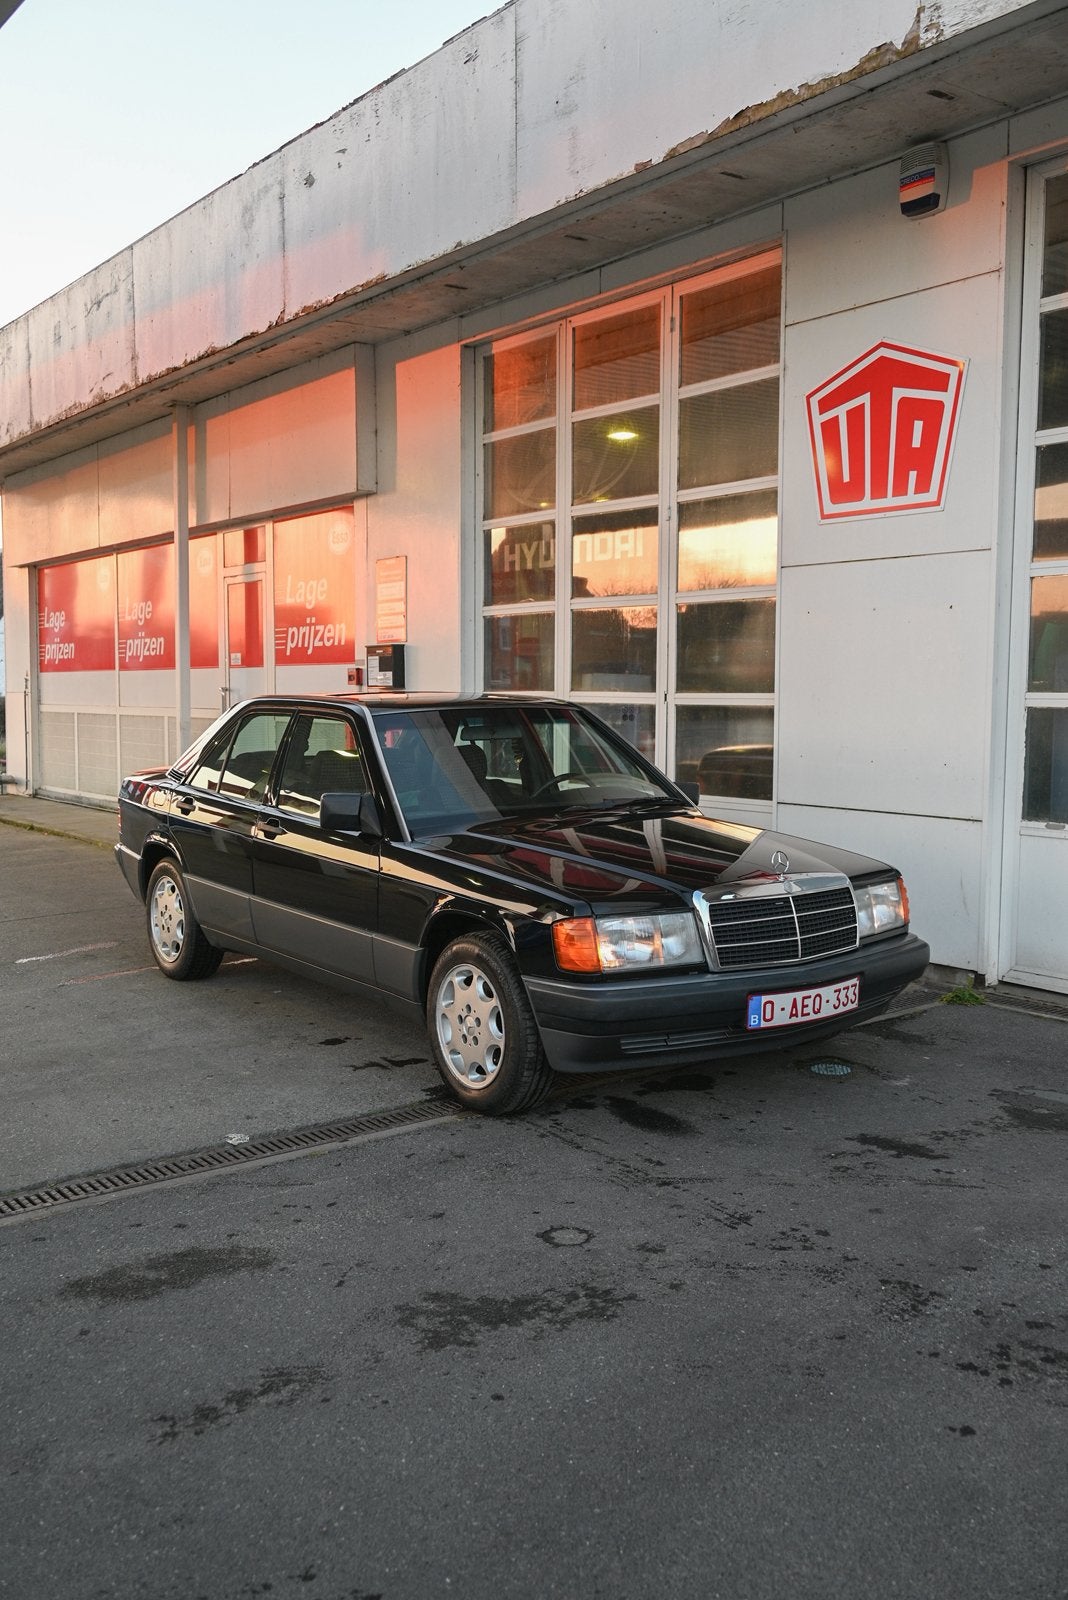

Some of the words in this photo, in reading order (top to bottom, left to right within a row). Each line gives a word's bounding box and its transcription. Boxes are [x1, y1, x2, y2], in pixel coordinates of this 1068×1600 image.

[817, 354, 951, 505] UTA
[285, 574, 328, 610] Lage
[44, 606, 66, 632] Lage
[124, 597, 153, 626] Lage
[44, 637, 75, 664] prijzen
[125, 631, 165, 662] prijzen
[285, 616, 347, 656] prijzen
[750, 1014, 759, 1025] B
